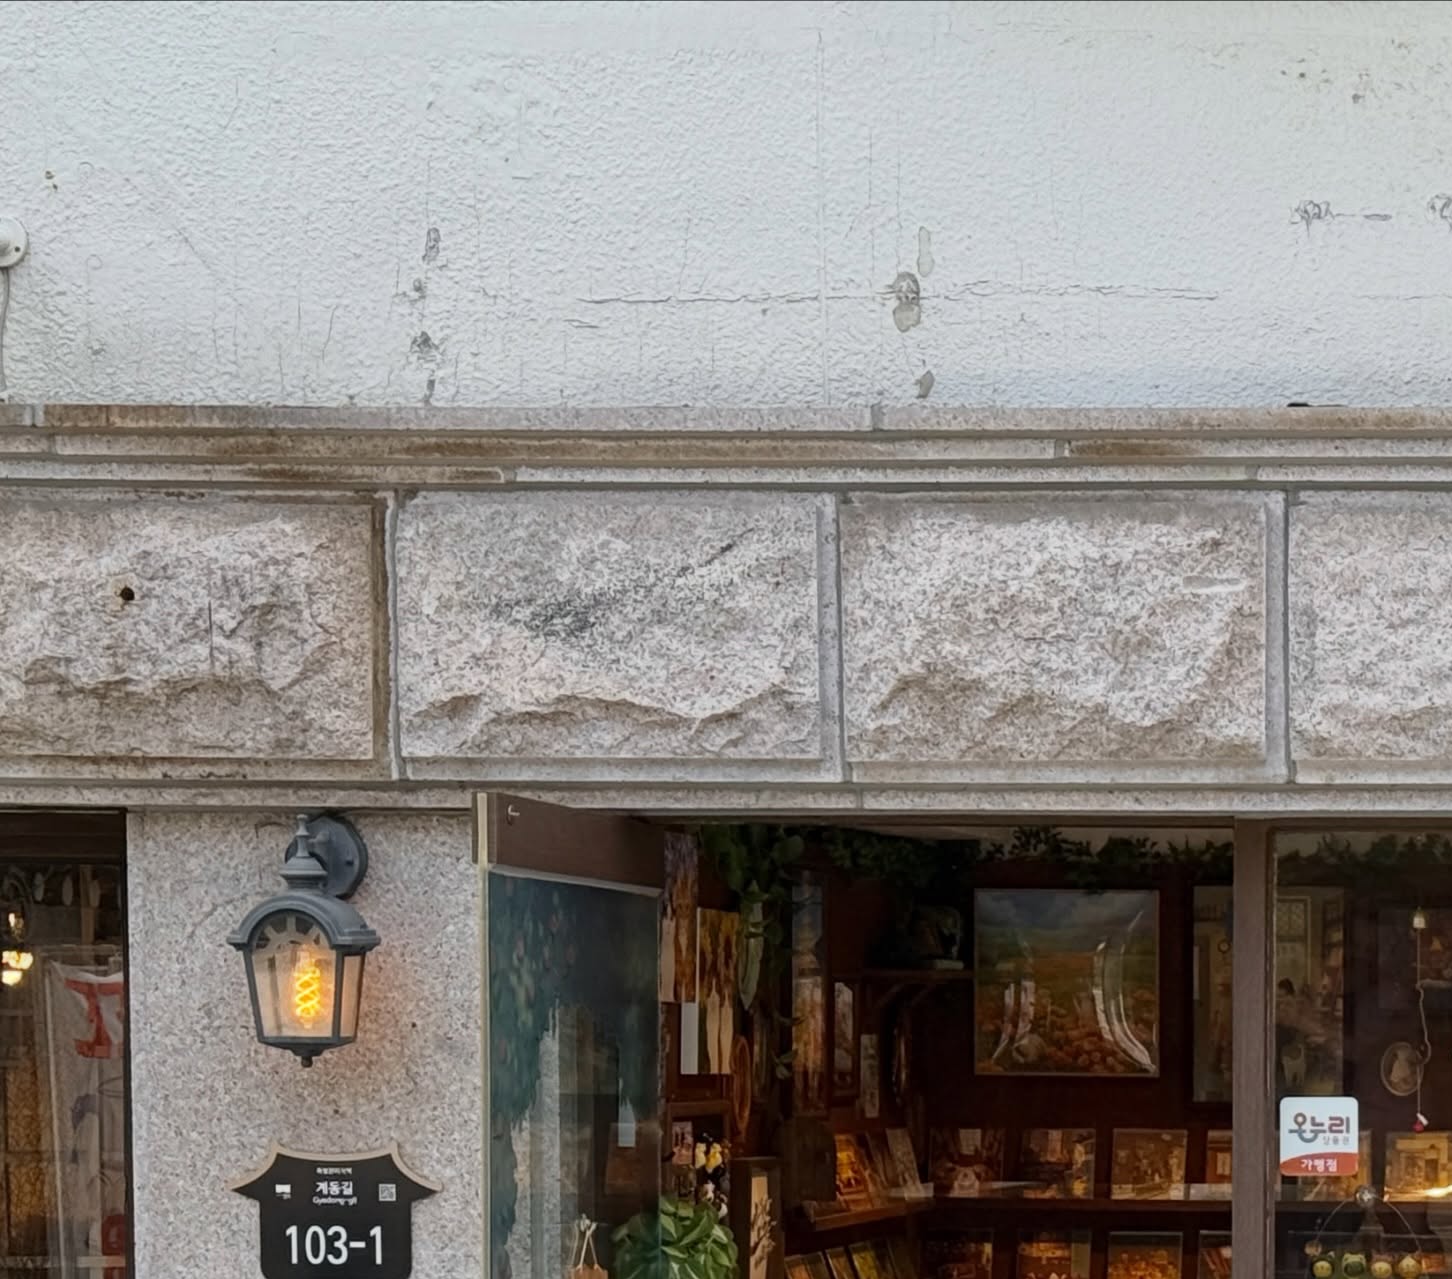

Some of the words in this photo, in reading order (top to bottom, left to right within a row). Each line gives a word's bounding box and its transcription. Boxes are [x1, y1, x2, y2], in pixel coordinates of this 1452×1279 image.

[1300, 1157, 1338, 1173] 가맹점
[315, 1180, 353, 1196] 계동길
[285, 1224, 382, 1265] 103-1
